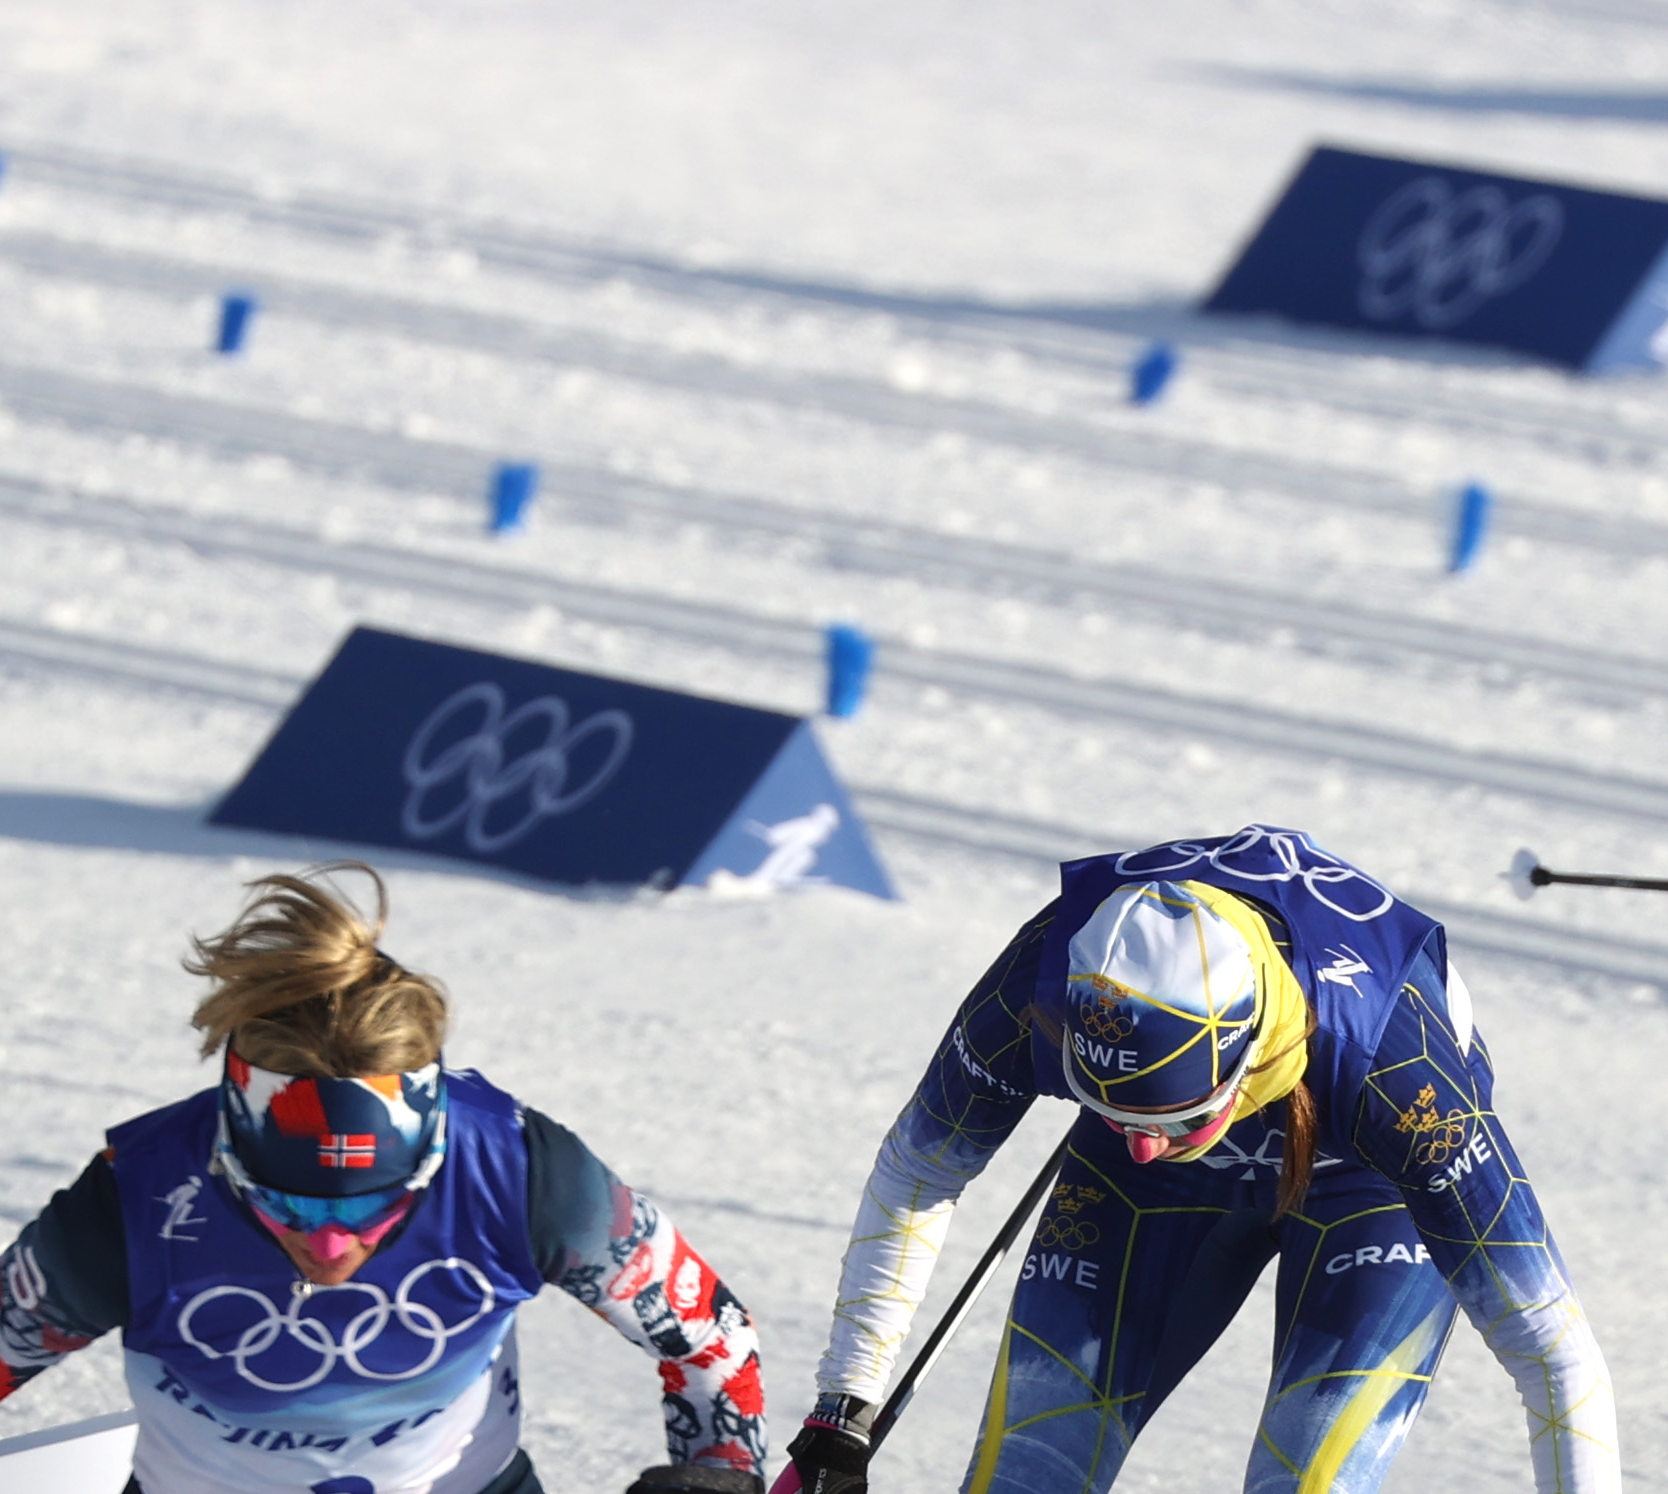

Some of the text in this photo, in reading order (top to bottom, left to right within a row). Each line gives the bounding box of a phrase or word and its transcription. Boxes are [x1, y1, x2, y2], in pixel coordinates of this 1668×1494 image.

[1217, 1011, 1256, 1050] CRAF
[953, 1025, 997, 1087] CRAFT
[1074, 1032, 1140, 1072] SWE
[1427, 1133, 1492, 1194] SWE
[1021, 1253, 1101, 1290] SWE
[1325, 1243, 1432, 1275] CRAF
